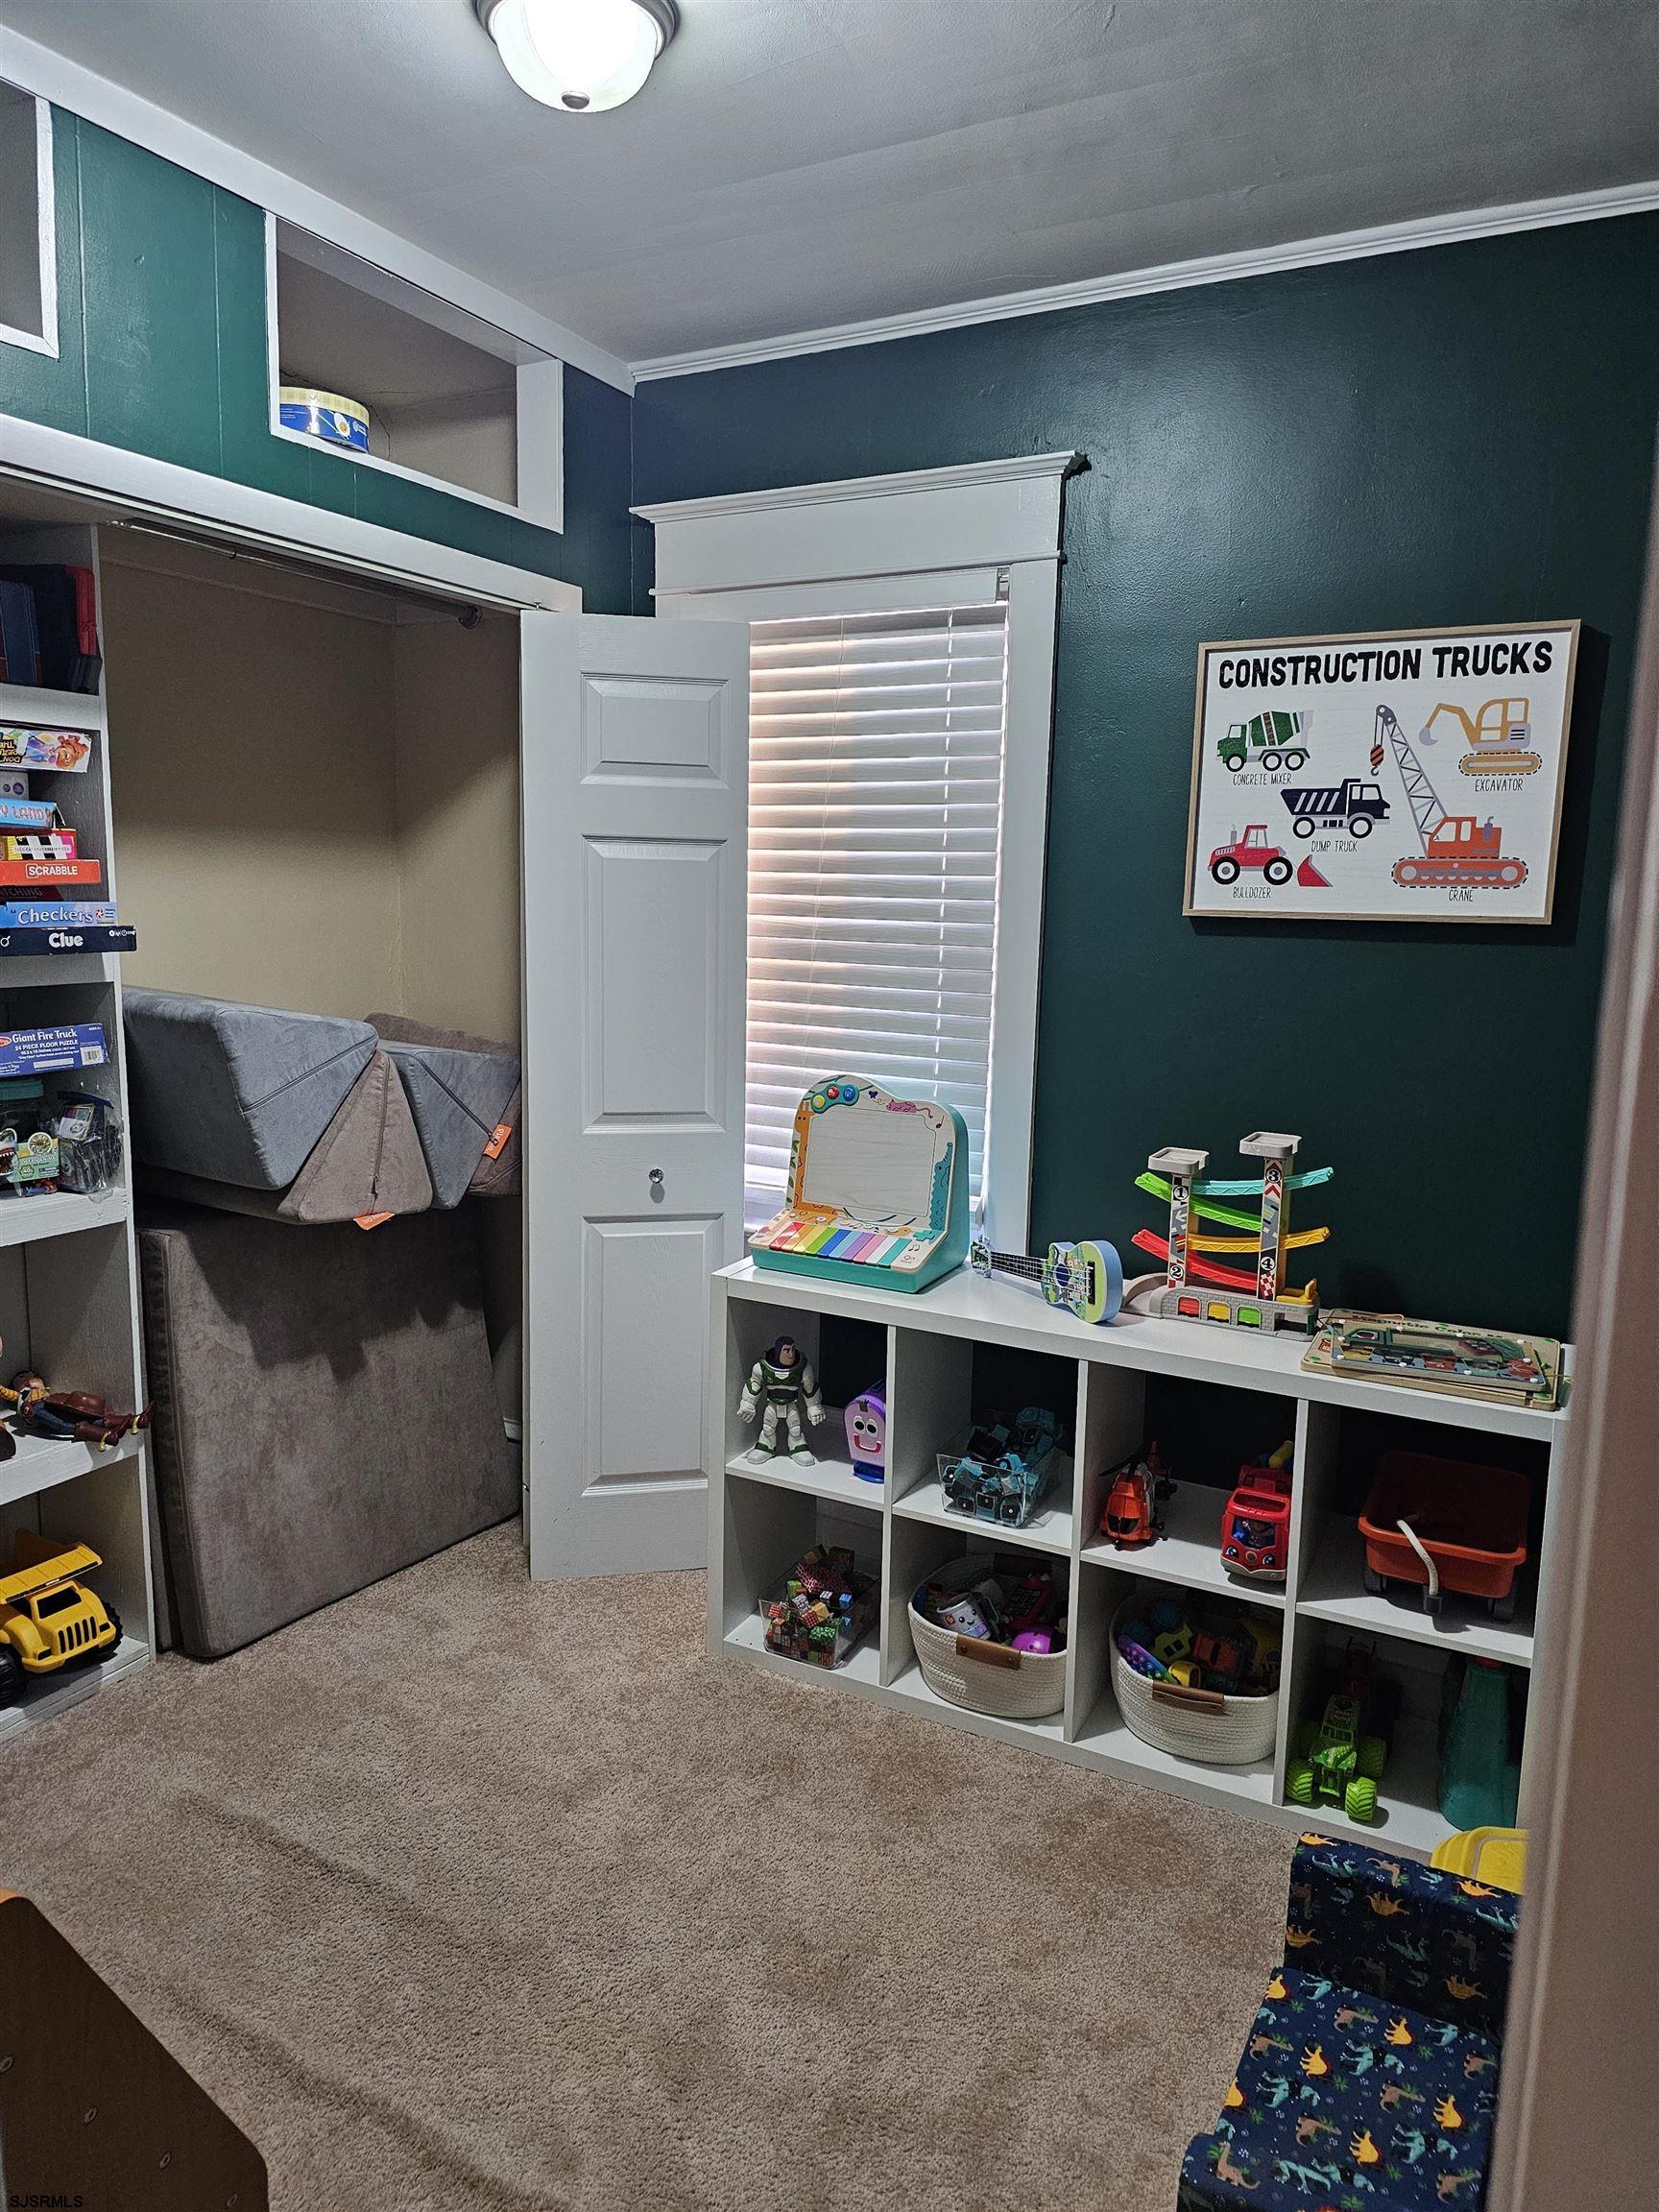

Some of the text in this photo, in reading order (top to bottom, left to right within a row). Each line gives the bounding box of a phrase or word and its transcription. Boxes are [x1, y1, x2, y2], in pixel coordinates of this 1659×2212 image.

[1218, 640, 1552, 688] CONSTRUCTION TRUCKS
[1233, 773, 1292, 786] CONCRETE MIXER
[1475, 779, 1524, 792] EXCAVATOR
[1311, 840, 1358, 853] DUMP TRUCK
[29, 866, 78, 876] SCRABBLE
[1233, 887, 1271, 899] BULLDOZER
[1449, 889, 1475, 902] CRANE
[18, 907, 93, 925] Checkers
[49, 932, 84, 949] Clue
[12, 1028, 78, 1044] Giant Fire Truck
[1179, 1189, 1185, 1198] 1
[1262, 1258, 1272, 1269] 4
[1172, 1267, 1182, 1277] 2
